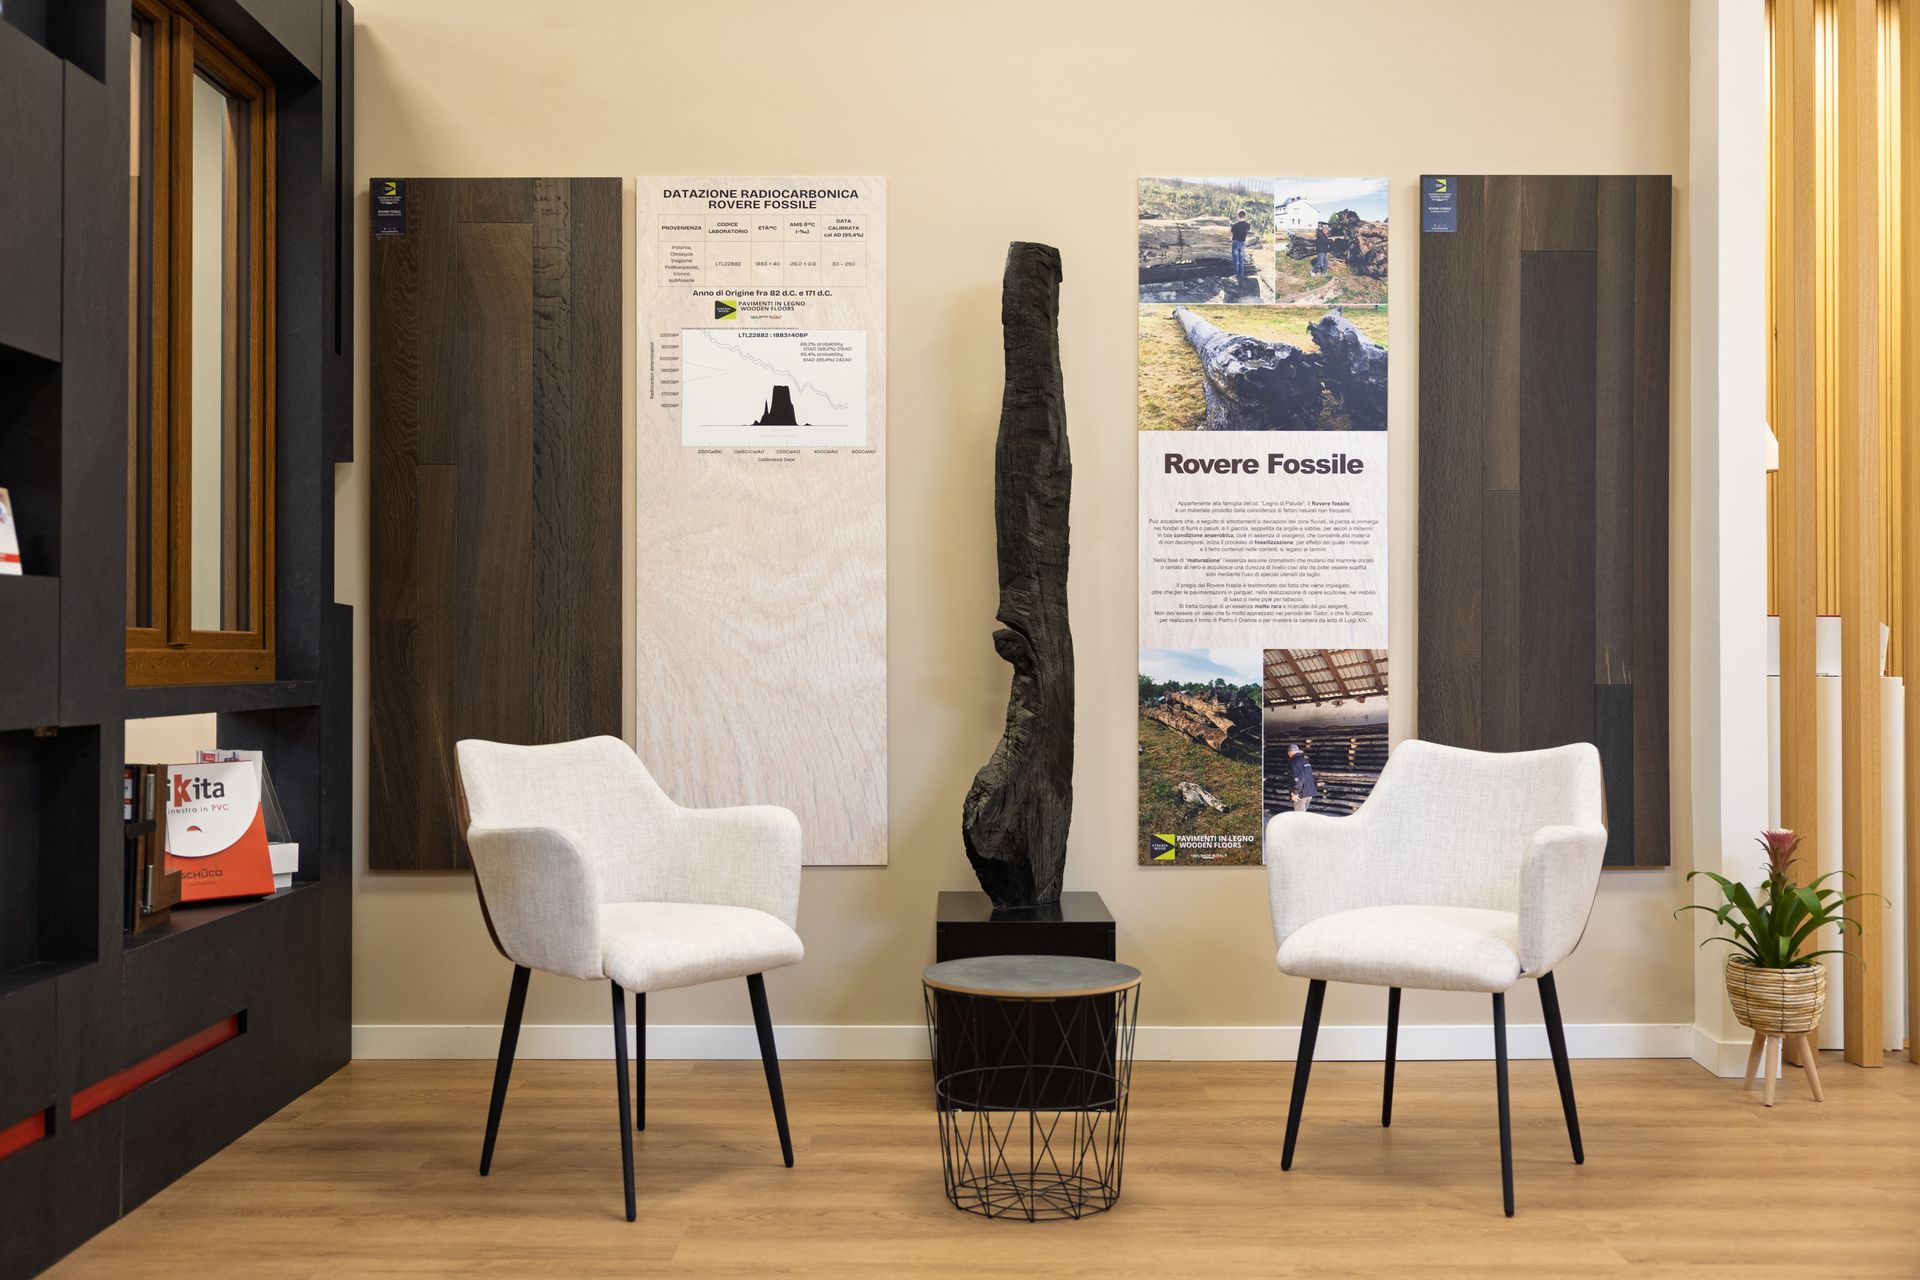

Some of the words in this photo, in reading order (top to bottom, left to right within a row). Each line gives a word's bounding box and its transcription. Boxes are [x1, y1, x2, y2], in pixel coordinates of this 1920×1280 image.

[664, 190, 737, 198] DATAZIONE
[741, 190, 858, 198] RADIOCARBONICA
[709, 200, 760, 209] ROVERE
[764, 200, 816, 209] FOSSILE
[1164, 453, 1259, 474] Rovere
[1268, 453, 1364, 474] Fossile
[166, 774, 225, 807] ikita
